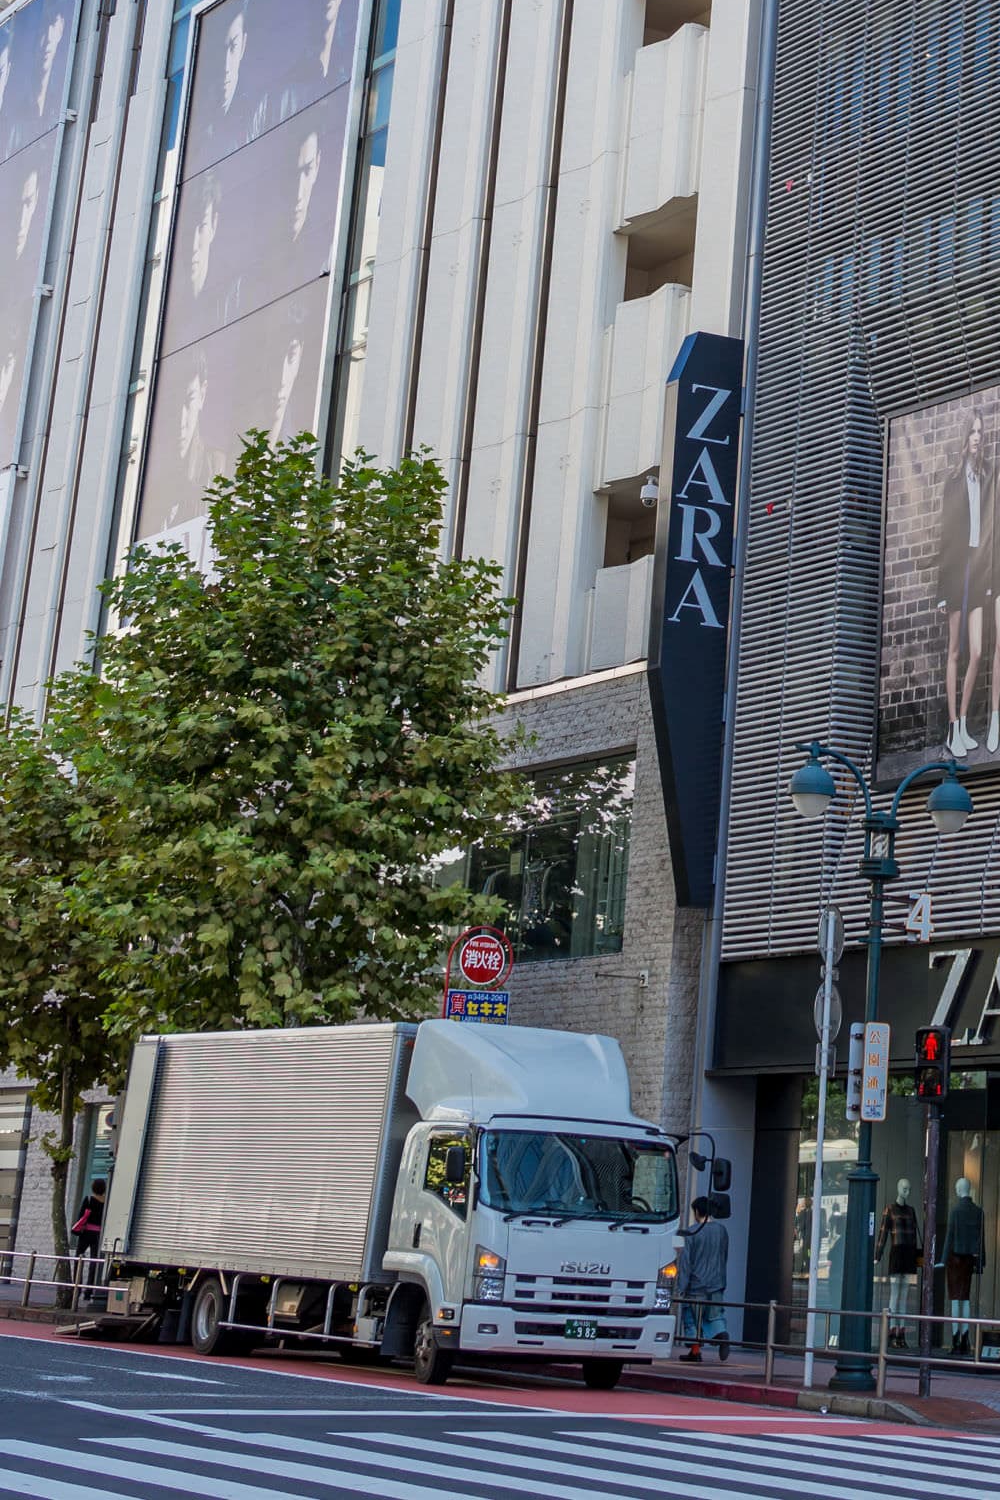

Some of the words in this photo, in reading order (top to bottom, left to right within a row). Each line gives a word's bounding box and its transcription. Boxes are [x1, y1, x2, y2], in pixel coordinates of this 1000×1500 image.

[667, 383, 732, 629] ZARA
[464, 949, 501, 971] 消火栓
[466, 1000, 507, 1017] セキネ
[559, 1261, 611, 1275] ISUZU
